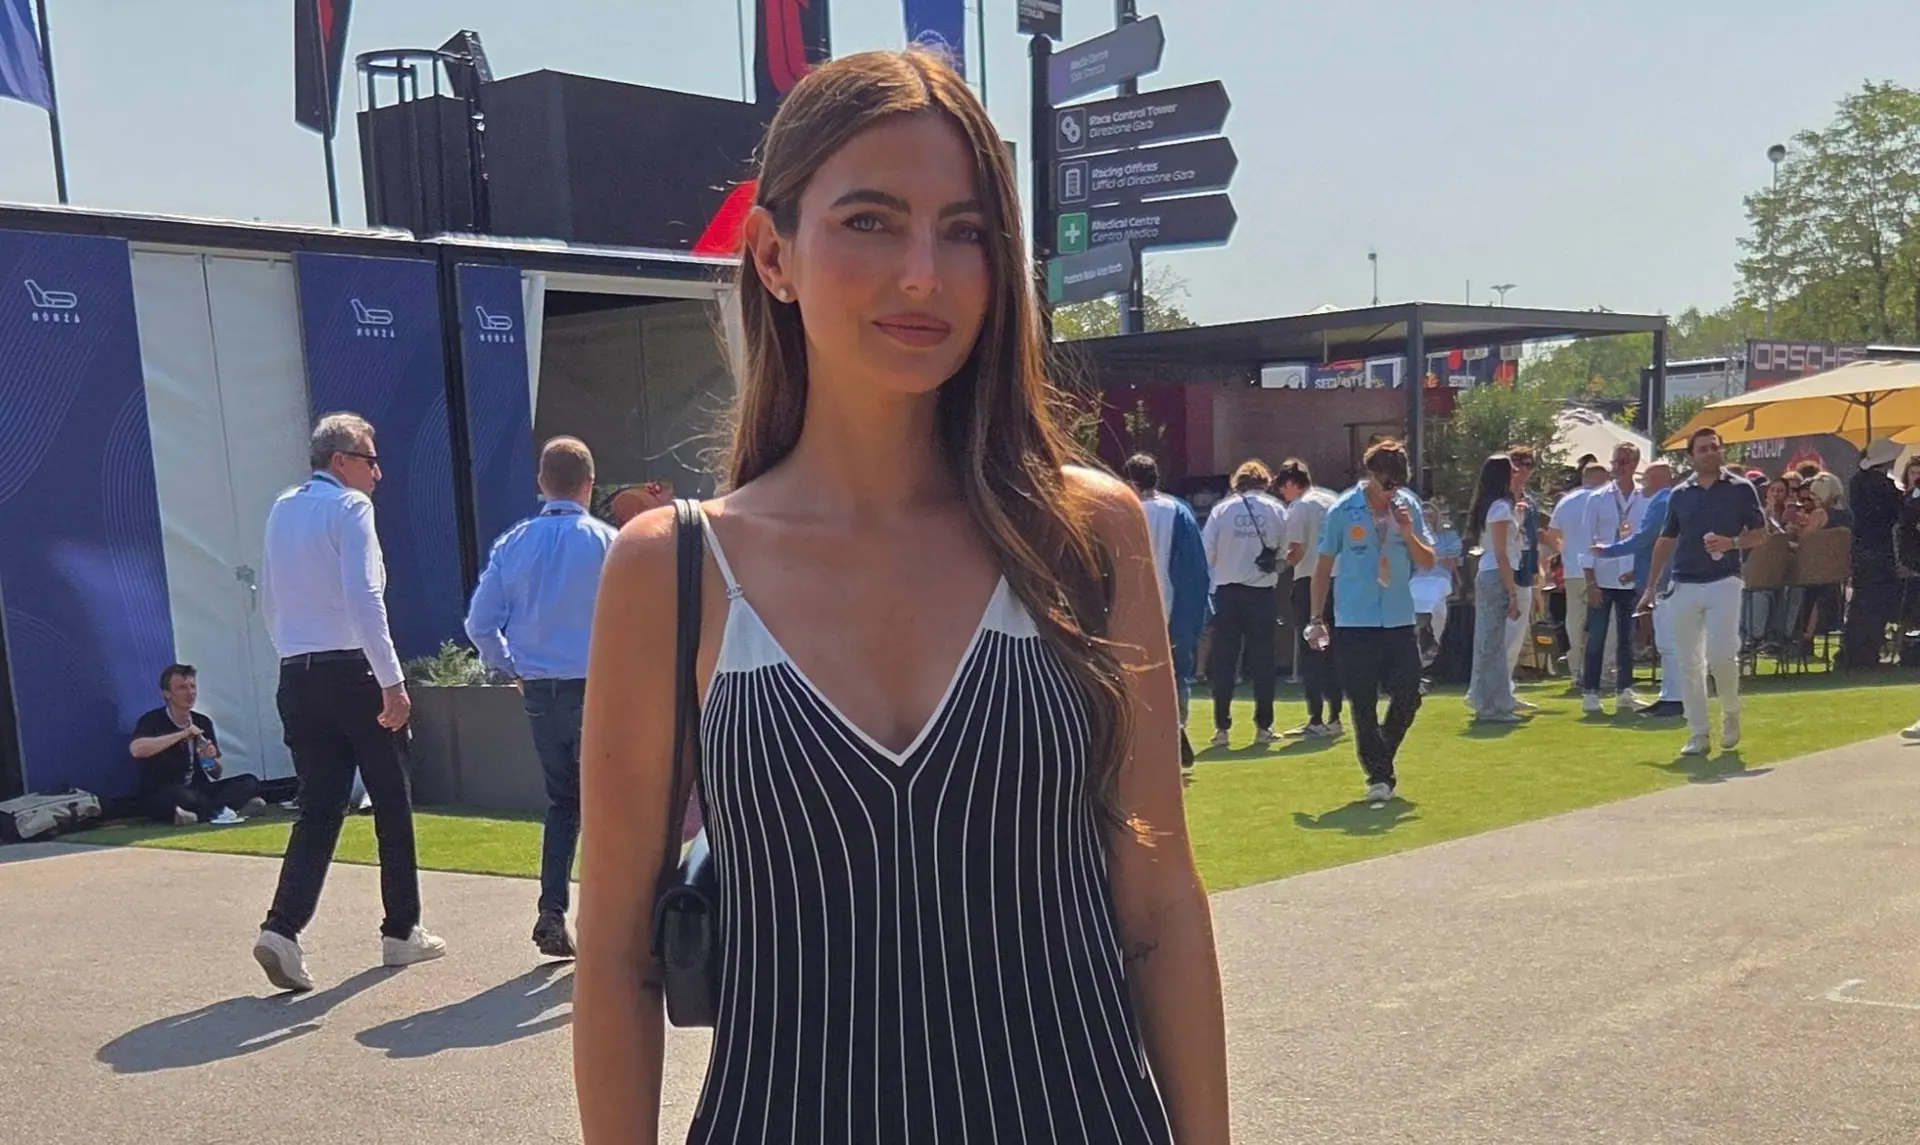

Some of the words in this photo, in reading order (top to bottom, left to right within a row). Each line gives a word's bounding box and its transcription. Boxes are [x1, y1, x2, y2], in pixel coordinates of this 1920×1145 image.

[1089, 115, 1111, 126] Race
[1112, 107, 1146, 122] Control
[1147, 103, 1178, 116] Tower
[1089, 124, 1132, 138] Direzione
[1092, 166, 1123, 178] Racing
[1124, 162, 1158, 174] Offices
[1126, 172, 1172, 187] Direzione
[1092, 217, 1128, 231] Medical
[1128, 216, 1160, 227] Centre
[1092, 231, 1124, 243] Centro
